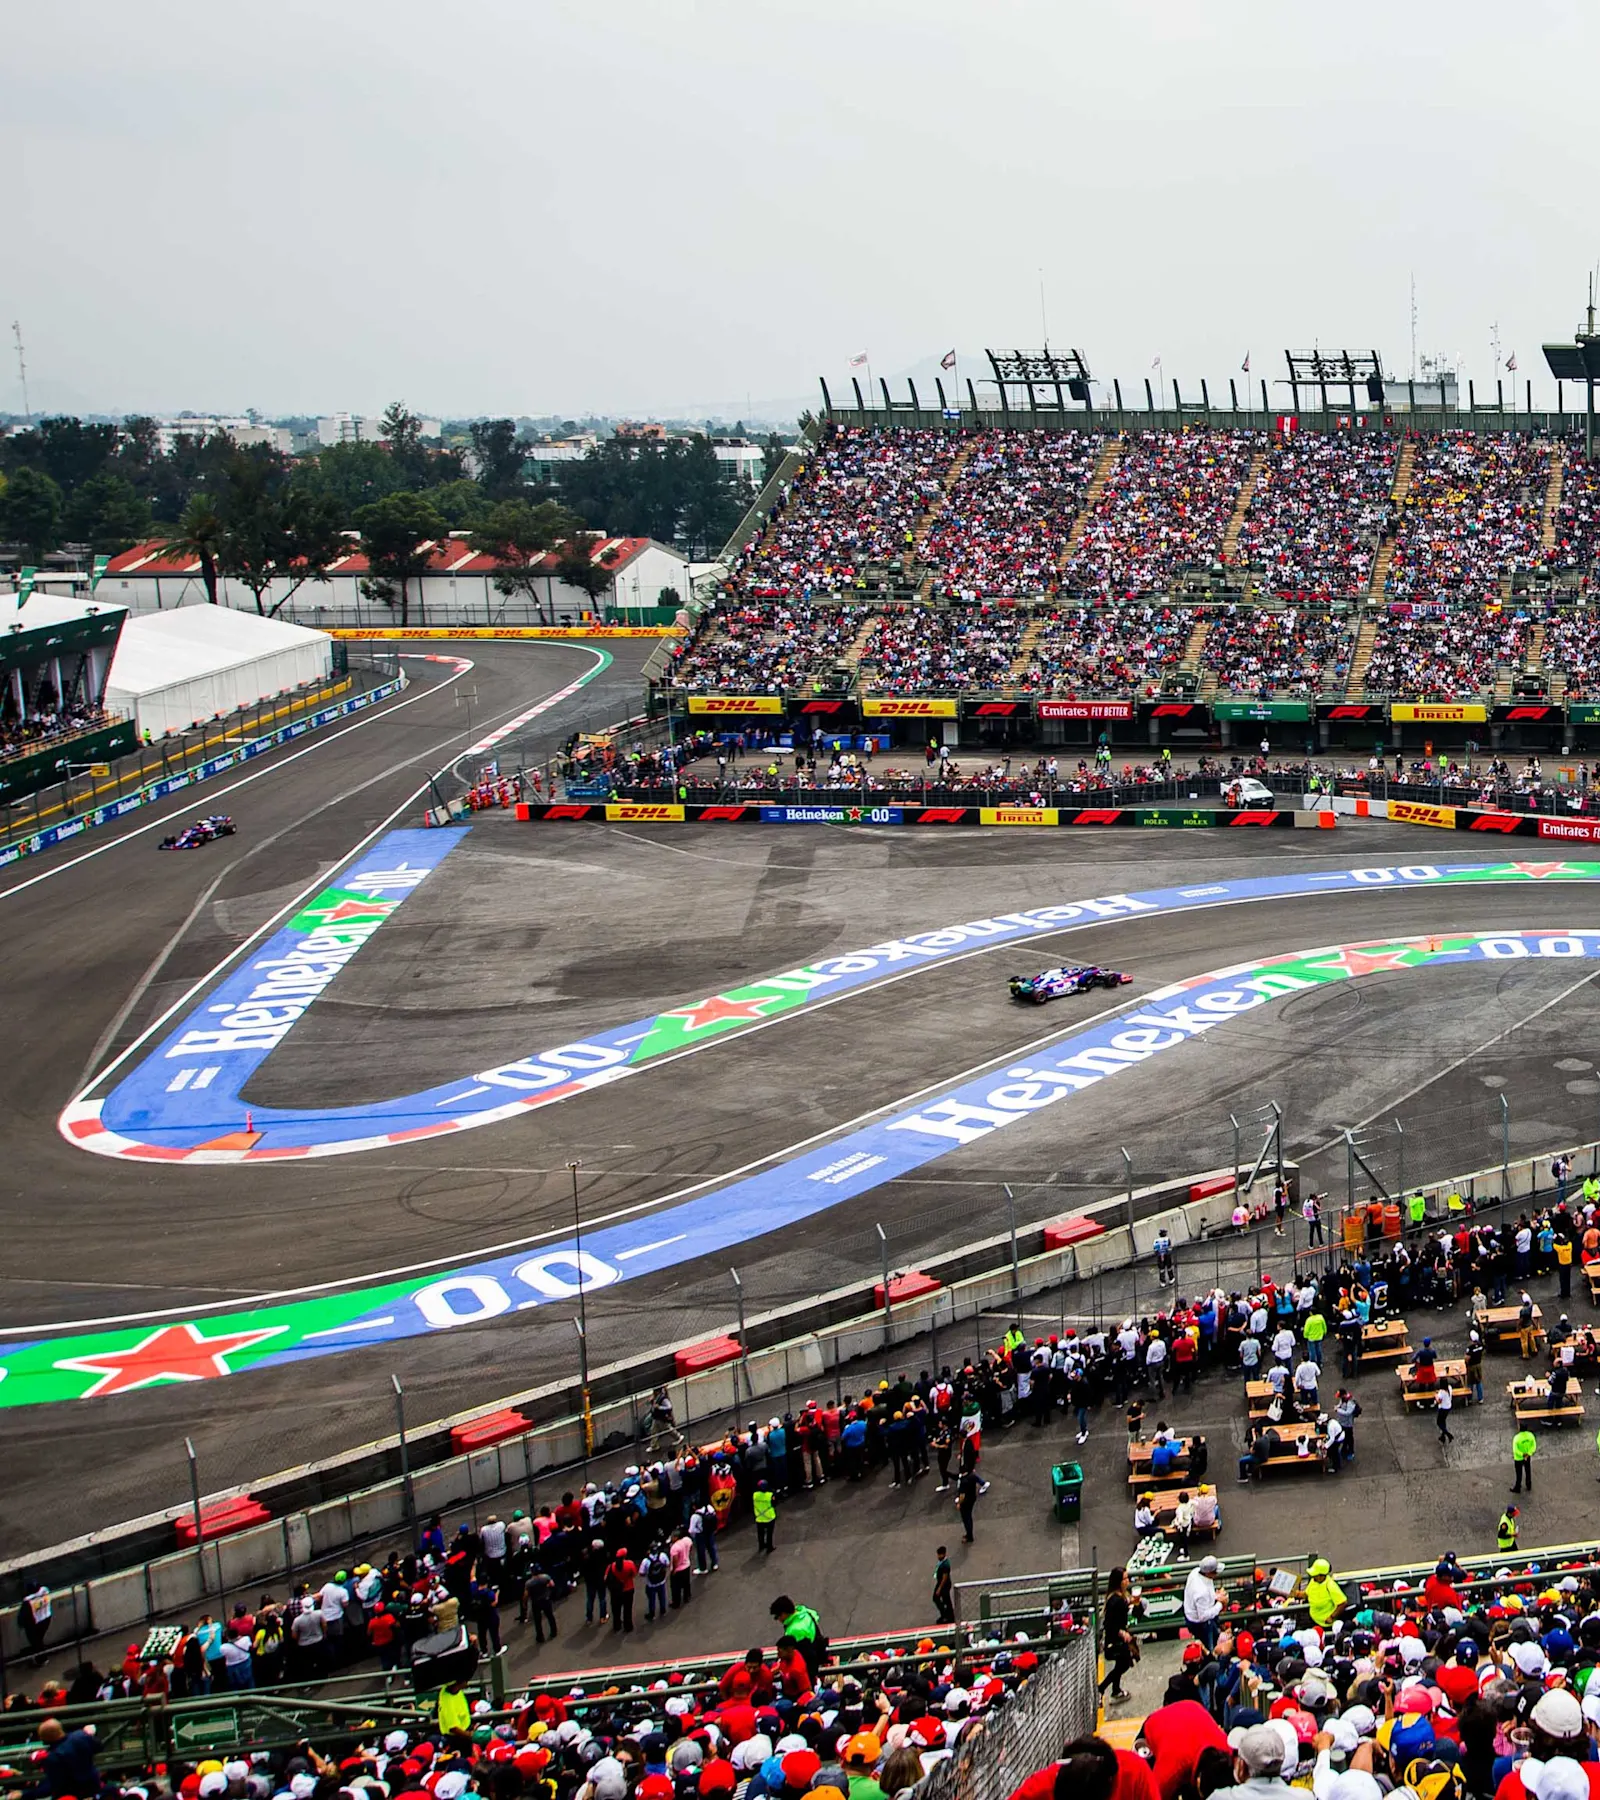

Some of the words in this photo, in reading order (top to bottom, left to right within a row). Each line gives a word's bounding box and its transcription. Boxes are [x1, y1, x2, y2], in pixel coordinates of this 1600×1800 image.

[706, 700, 760, 711] DHL
[878, 703, 934, 714] DHL
[1042, 706, 1088, 716] Emirates
[1091, 707, 1102, 717] FLY
[1104, 707, 1128, 717] BETTER
[1413, 707, 1464, 719] PIRELLI
[620, 808, 671, 818] DHL
[786, 809, 844, 821] Heineken
[996, 810, 1043, 823] PIRELLI
[1394, 804, 1444, 824] DHL
[1543, 823, 1589, 838] Emirates
[751, 894, 1159, 990] Heineken
[165, 920, 383, 1058] Heineken
[886, 972, 1322, 1144] Heineken
